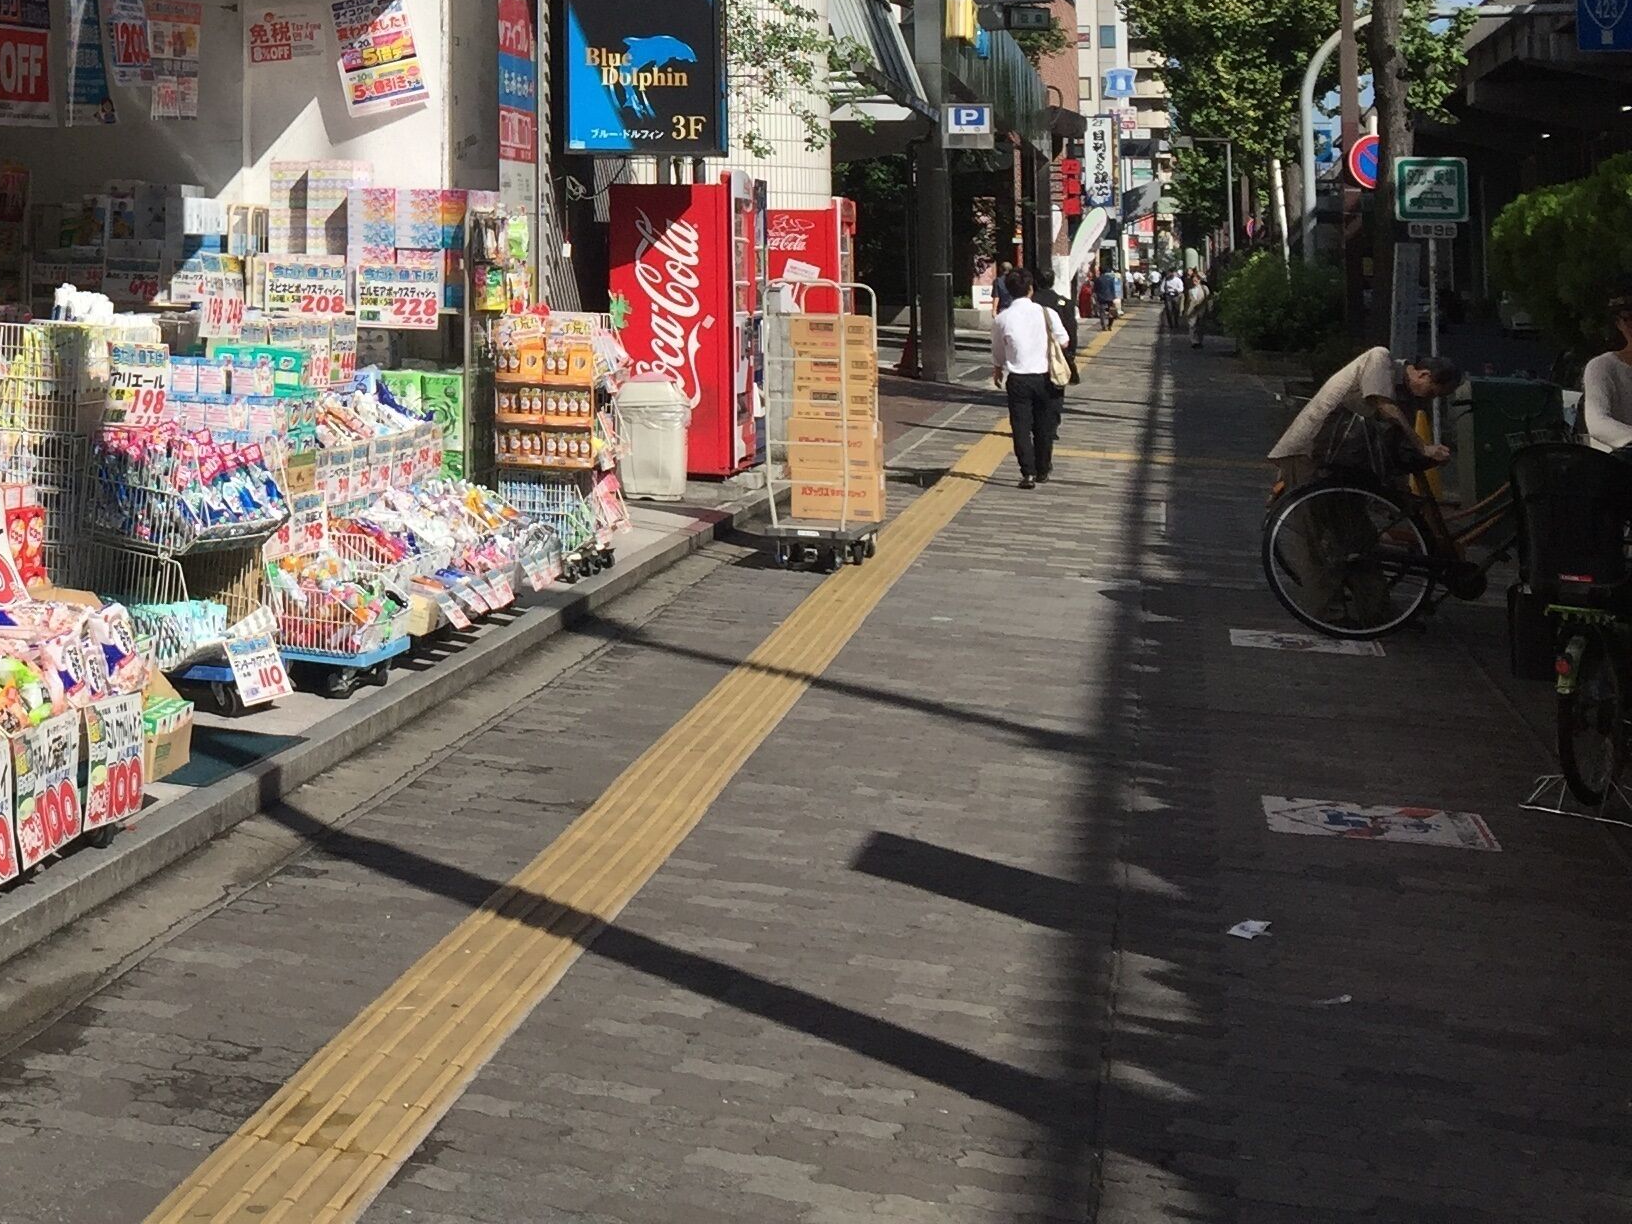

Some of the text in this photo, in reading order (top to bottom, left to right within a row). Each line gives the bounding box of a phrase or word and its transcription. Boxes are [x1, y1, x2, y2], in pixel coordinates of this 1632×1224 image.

[1595, 1, 1619, 20] 423
[250, 21, 291, 44] 免税
[585, 47, 633, 67] Blue
[601, 66, 689, 91] Dolphin
[960, 108, 979, 122] P
[671, 114, 706, 141] 3F
[301, 295, 345, 314] 208
[392, 298, 438, 317] 228
[111, 371, 166, 390] アリエール
[130, 388, 166, 415] 198
[258, 664, 283, 688] 110
[106, 754, 142, 819] 100
[36, 777, 80, 851] 100
